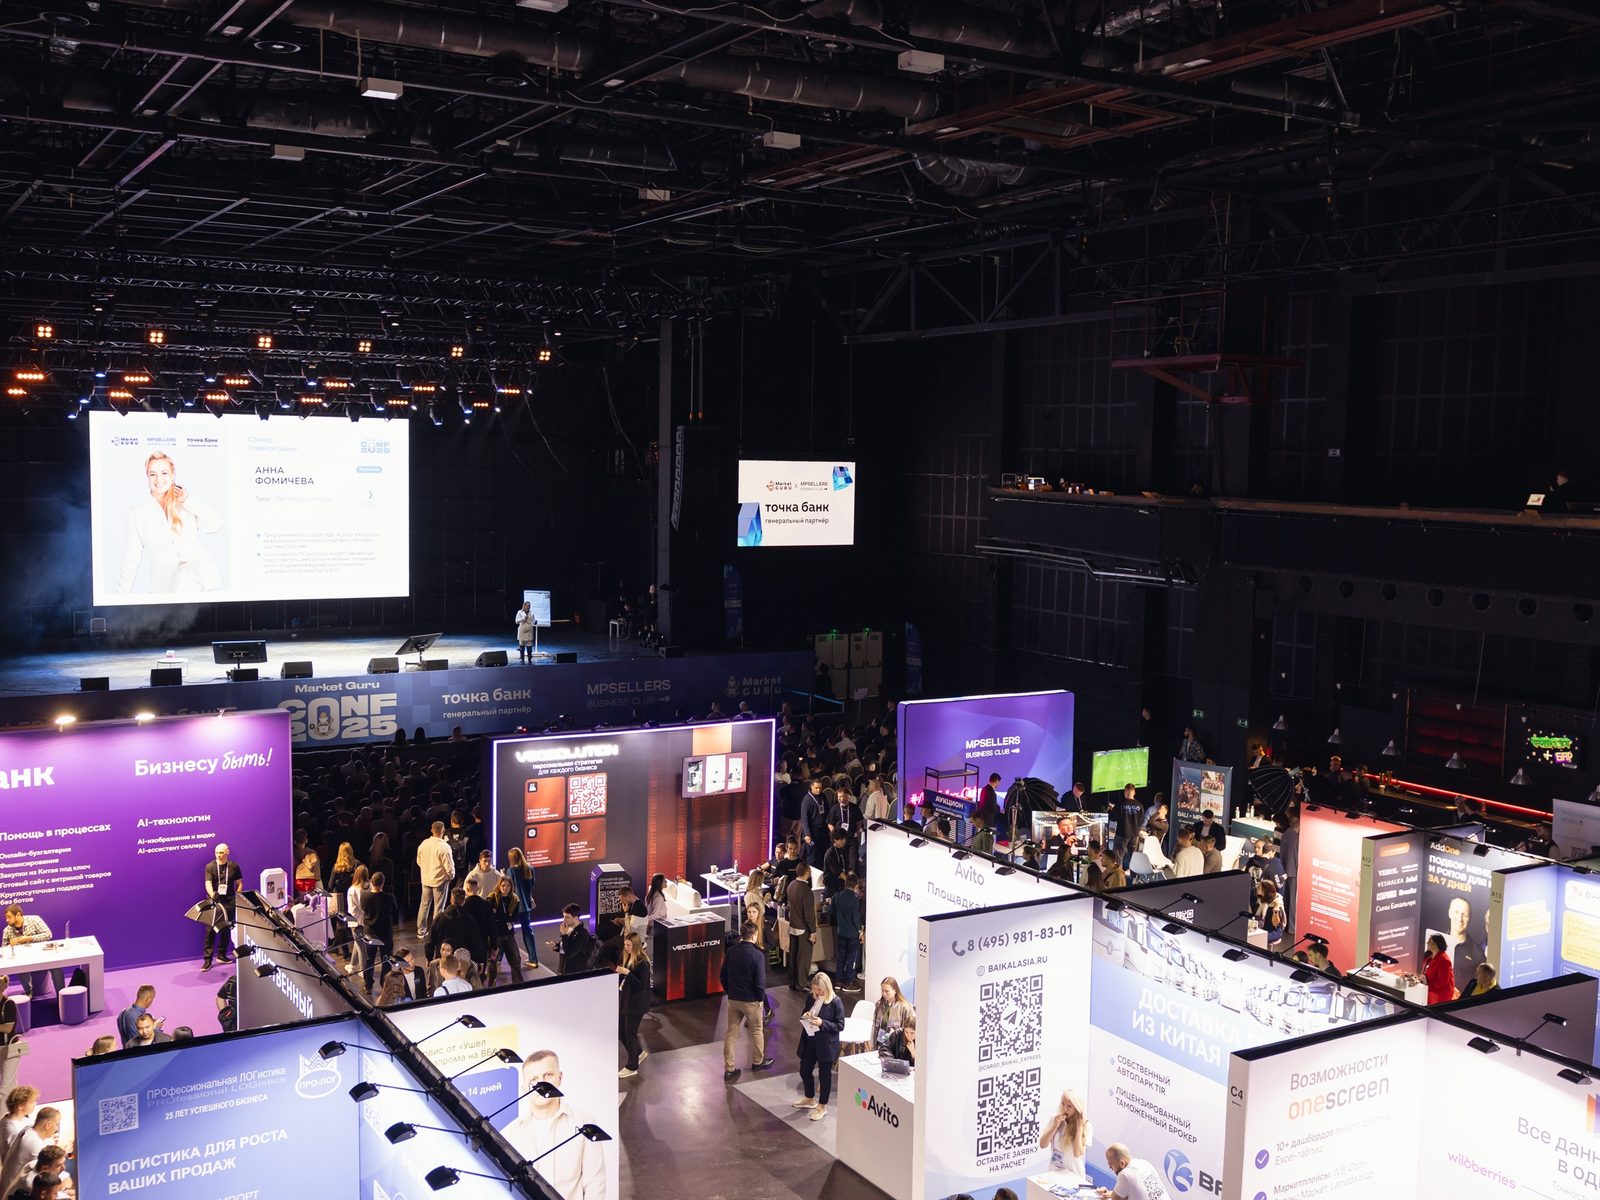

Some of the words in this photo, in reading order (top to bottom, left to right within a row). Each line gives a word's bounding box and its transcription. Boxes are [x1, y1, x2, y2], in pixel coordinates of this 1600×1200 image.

[255, 466, 285, 474] АННА
[255, 477, 315, 486] ФОМИЧЕВА
[765, 504, 799, 513] точка
[801, 501, 830, 512] банк
[765, 517, 804, 525] генеральный
[294, 681, 343, 693] Market
[345, 680, 380, 690] Guru
[586, 679, 671, 696] MPSELLERS
[743, 676, 782, 686] Market
[441, 691, 490, 705] точка
[492, 687, 532, 702] банк
[443, 706, 498, 719] генеральный
[965, 735, 1021, 749] MPSELLERS
[135, 757, 219, 776] Бизнесу
[221, 748, 273, 770] быть!
[965, 750, 993, 759] BUSINESS
[994, 748, 1010, 756] CLUB
[935, 795, 964, 810] АУКЦИОН
[0, 831, 45, 841] Помощь
[46, 829, 53, 837] в
[54, 823, 112, 838] процессах
[196, 832, 216, 840] видео
[1430, 842, 1460, 856] AddOne
[1429, 854, 1466, 870] ПОДБОР
[38, 867, 59, 876] Китая
[954, 861, 985, 886] Avito
[1428, 864, 1436, 873] И
[1436, 866, 1467, 882] РОПОВ
[1467, 874, 1487, 887] ДЛЯ
[1427, 873, 1440, 884] ЗА
[1440, 877, 1447, 885] 7
[1447, 879, 1472, 893] ДНЕЙ
[893, 888, 912, 903] для
[672, 939, 721, 951] VEOSOLUTION
[967, 939, 975, 951] 8
[978, 932, 1010, 951] (495)
[1013, 923, 1073, 944] 981-83-01
[918, 942, 928, 953] C2
[988, 955, 1048, 973] BAIKALASIA.RU
[1138, 989, 1241, 1045] ДОСТАВКА
[1132, 1009, 1156, 1037] ИЗ
[1159, 1020, 1222, 1068] КИТАЯ
[446, 1045, 456, 1054] от
[468, 1052, 479, 1060] на
[1117, 1054, 1171, 1086] СОБСТВЕННЫЙ
[1290, 1053, 1389, 1091] Возможности
[146, 1075, 238, 1100] ПРОфессиональная
[239, 1066, 286, 1082] ЛОГистика
[299, 1075, 339, 1089] ПРО-ЛОГ
[468, 1086, 478, 1097] 14
[480, 1081, 502, 1096] дней
[1117, 1066, 1154, 1091] АВТОПАРК
[1155, 1084, 1166, 1096] TIR
[1230, 1085, 1243, 1100] C4
[1288, 1076, 1390, 1120] onescreen
[165, 1111, 174, 1121] 25
[174, 1108, 189, 1119] ЛЕТ
[189, 1098, 234, 1116] УСПЕШНОГО
[235, 1093, 268, 1107] БИЗНЕСА
[867, 1095, 899, 1128] Avito
[1115, 1086, 1191, 1131] ЛИЦЕНЗИРОВАННЫЙ
[1115, 1097, 1167, 1131] ТАМОЖЕННЫЙ
[1168, 1123, 1198, 1145] БРОКЕР
[1517, 1116, 1551, 1144] Все
[107, 1147, 201, 1177] ЛОГИСТИКА
[204, 1139, 236, 1158] ДЛЯ
[239, 1129, 289, 1149] РОСТА
[1276, 1141, 1289, 1152] 10+
[976, 1152, 1010, 1167] ОСТАВЬТЕ
[1012, 1145, 1039, 1159] ЗАЯВКУ
[989, 1165, 1000, 1173] НА
[1000, 1157, 1026, 1171] РАСЧЕТ
[1447, 1151, 1517, 1190] wildberries
[108, 1172, 168, 1195] ВАШИХ
[170, 1157, 237, 1181] ПРОДАЖ
[1573, 1166, 1600, 1191] од
